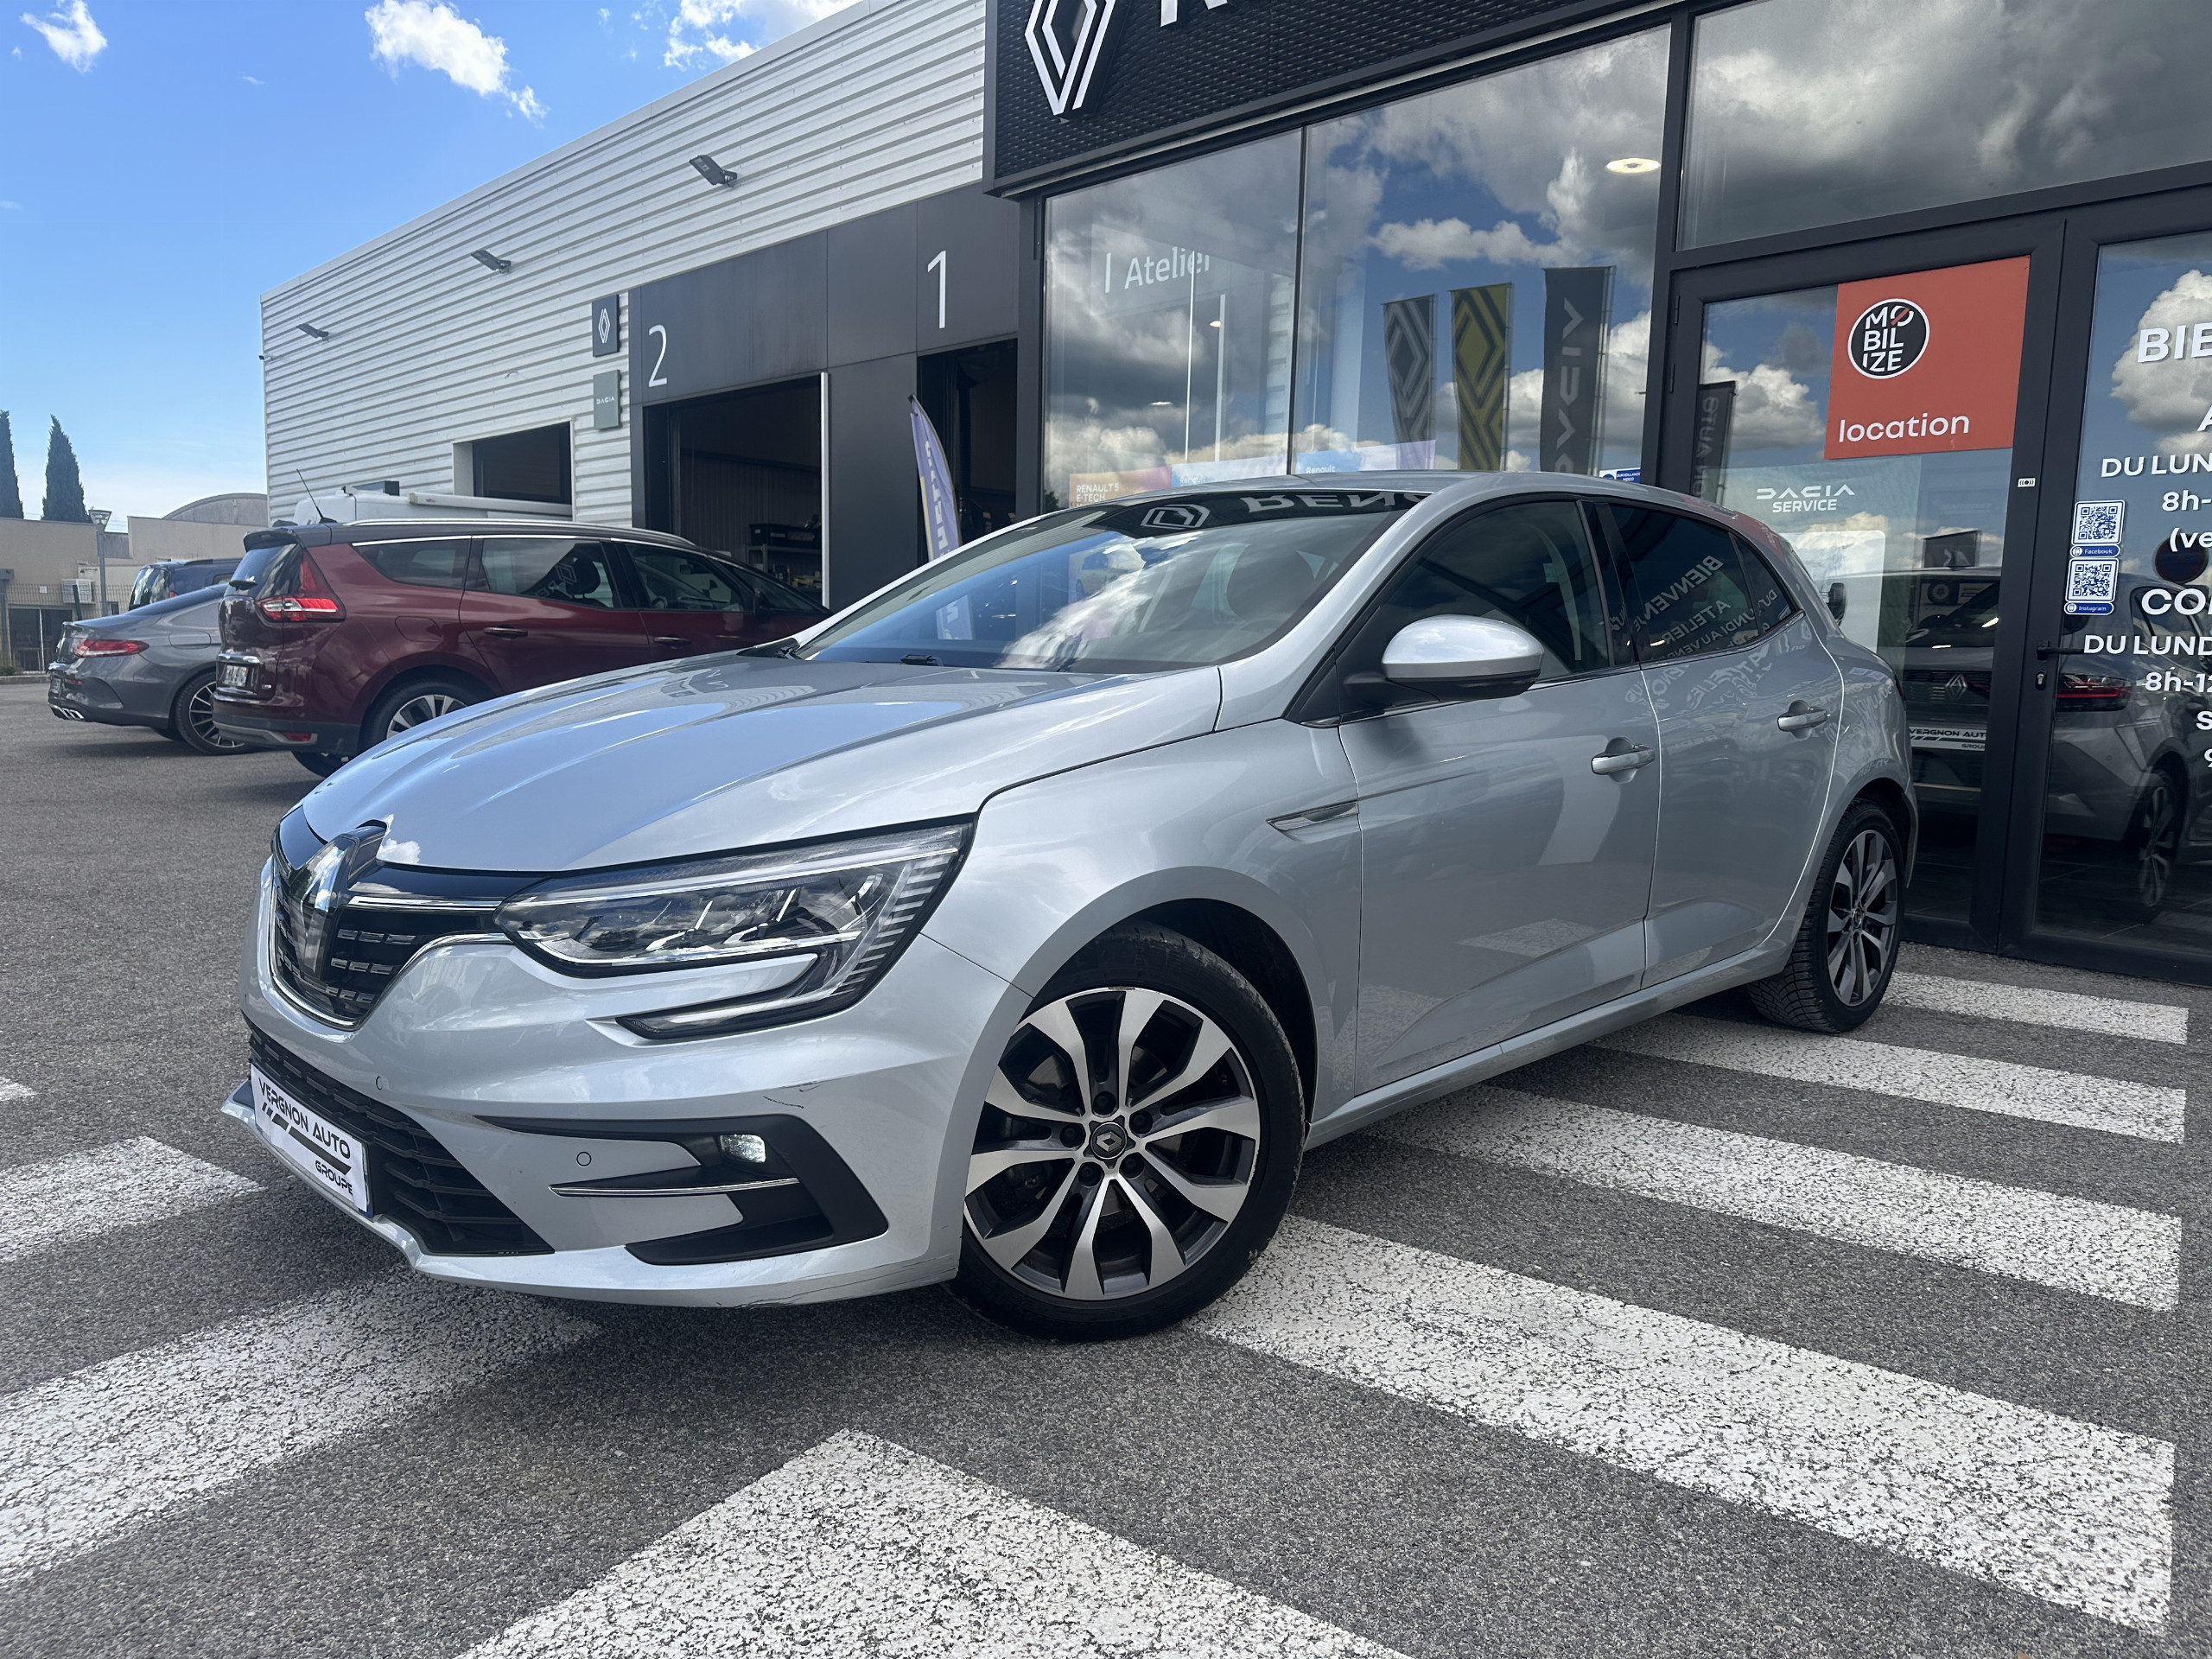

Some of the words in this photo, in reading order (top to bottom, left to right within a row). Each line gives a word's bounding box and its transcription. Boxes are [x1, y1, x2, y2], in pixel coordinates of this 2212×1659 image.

[927, 250, 946, 329] 1
[2137, 322, 2212, 363] BIE
[649, 324, 667, 387] 2
[596, 396, 615, 404] DACIA
[1838, 412, 1970, 442] location
[1306, 465, 1336, 474] Renault
[2101, 456, 2145, 478] DU
[1076, 483, 1114, 493] RENAULT
[1114, 483, 1120, 492] 5
[1076, 493, 1106, 502] E-TECH
[1757, 484, 1855, 499] DACIA
[1772, 499, 1837, 512] SERVICE
[2083, 634, 2126, 654] DU
[1909, 728, 1960, 737] VERGNON
[258, 1077, 309, 1133] VERGNON
[312, 1122, 351, 1160] AUTO
[315, 1160, 353, 1197] GROUPE
